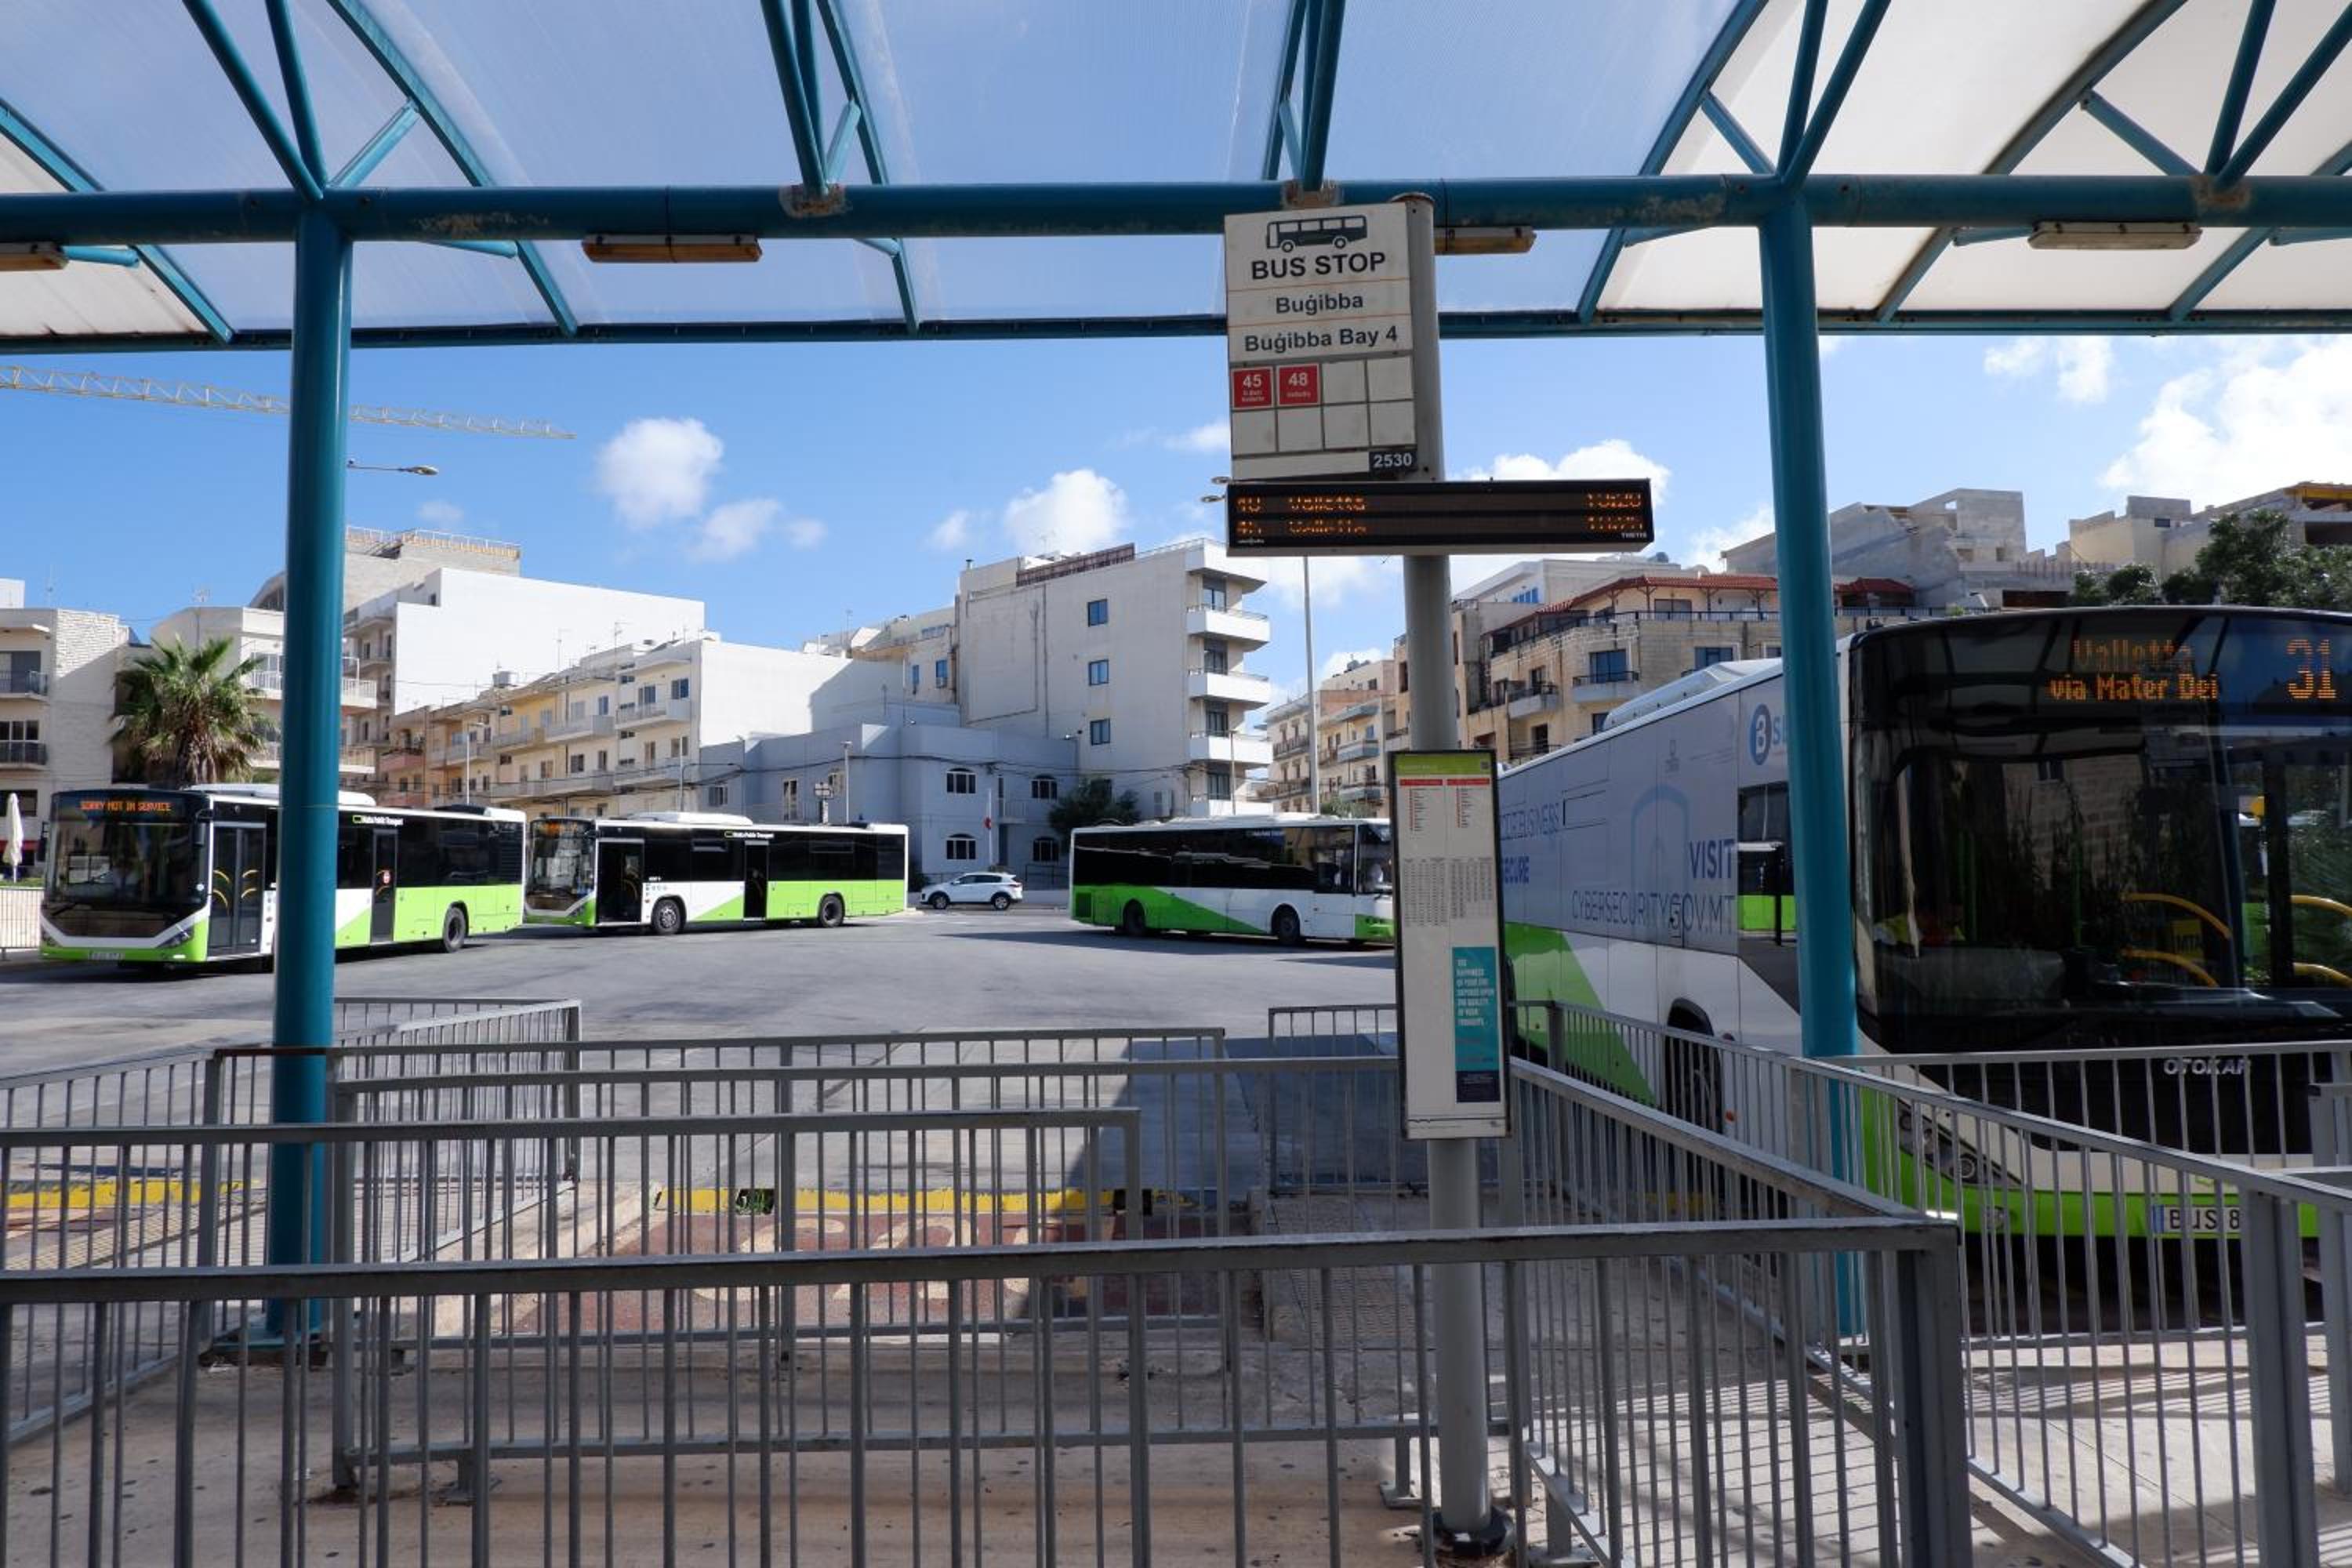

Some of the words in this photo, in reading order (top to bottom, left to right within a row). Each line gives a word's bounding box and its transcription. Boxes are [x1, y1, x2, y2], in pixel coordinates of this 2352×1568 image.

[1252, 258, 1306, 280] BUS
[1315, 252, 1385, 275] STOP
[1276, 292, 1363, 315] Buġibba
[1244, 332, 1332, 353] Buġibba
[1339, 328, 1379, 347] Bay
[1385, 325, 1398, 342] 4
[1243, 374, 1262, 388] 45
[1288, 372, 1308, 387] 48
[1373, 452, 1413, 468] 2530
[2074, 639, 2192, 669] Valletta
[2286, 638, 2338, 700] 31
[2049, 673, 2087, 700] via
[2096, 673, 2169, 701] Mater
[2178, 673, 2218, 699] Dei
[1690, 838, 1735, 880] VISIT
